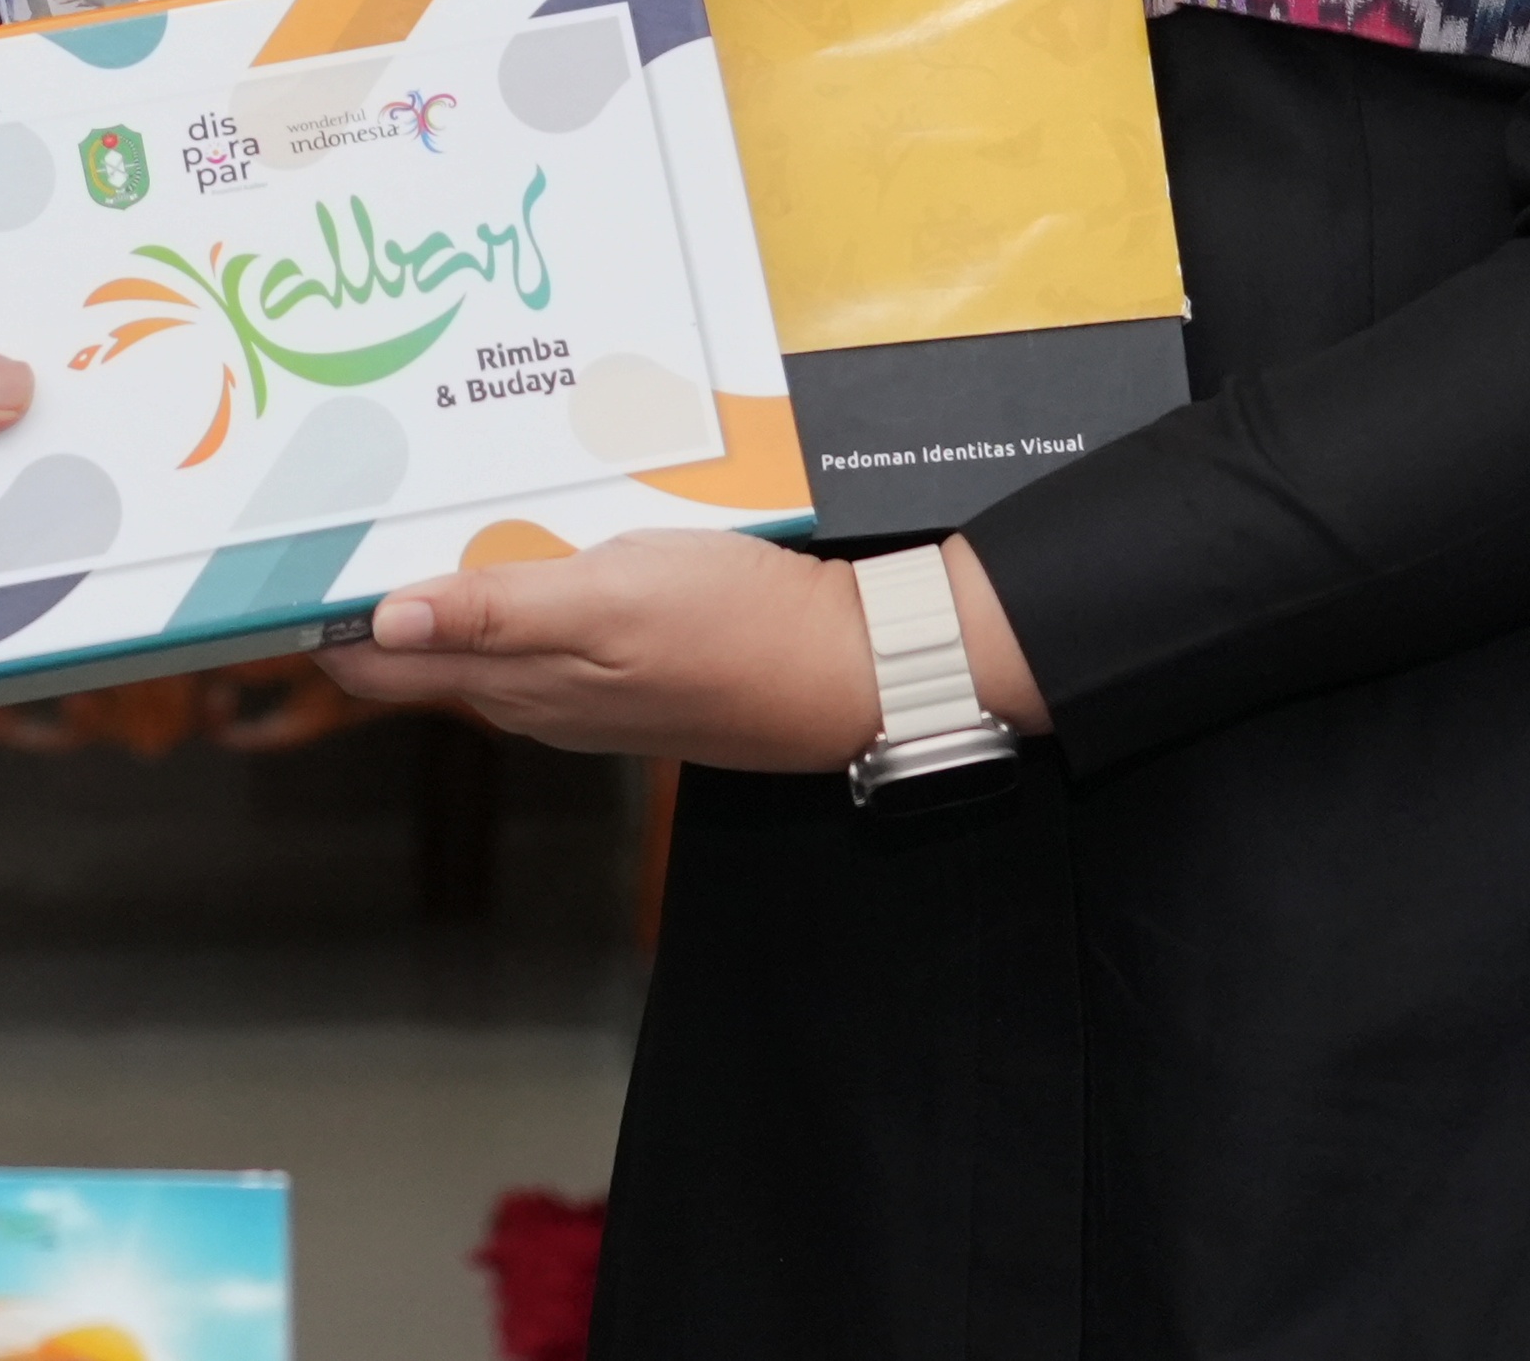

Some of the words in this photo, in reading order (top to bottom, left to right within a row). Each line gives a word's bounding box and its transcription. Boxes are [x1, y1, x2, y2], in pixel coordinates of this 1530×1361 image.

[187, 112, 238, 142] dis
[286, 108, 368, 134] wonderful
[289, 122, 401, 155] indonesia
[195, 159, 252, 195] par
[476, 337, 570, 371] Rimba
[436, 384, 457, 409] &
[465, 364, 577, 404] Budaya
[820, 449, 916, 471] Pedoman
[922, 441, 1016, 464] Identitas
[1020, 432, 1085, 456] Visual
